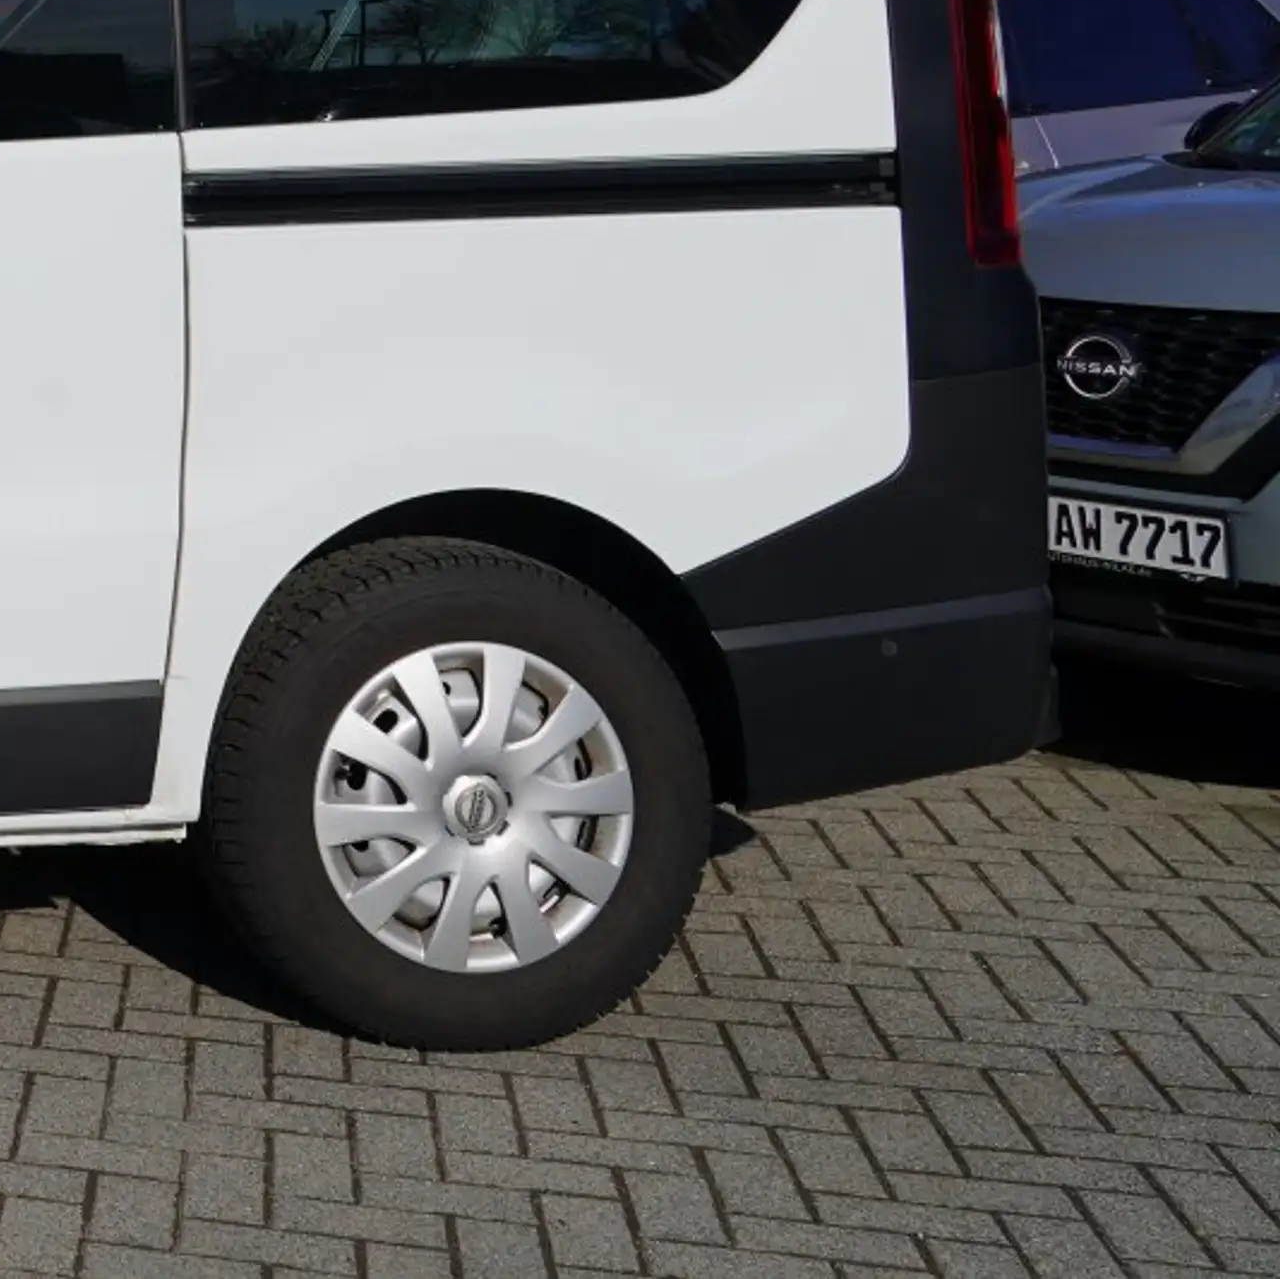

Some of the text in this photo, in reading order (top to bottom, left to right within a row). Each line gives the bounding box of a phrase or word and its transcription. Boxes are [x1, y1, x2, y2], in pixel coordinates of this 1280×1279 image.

[1056, 359, 1137, 377] NISSAN
[1055, 503, 1221, 569] AW 7717
